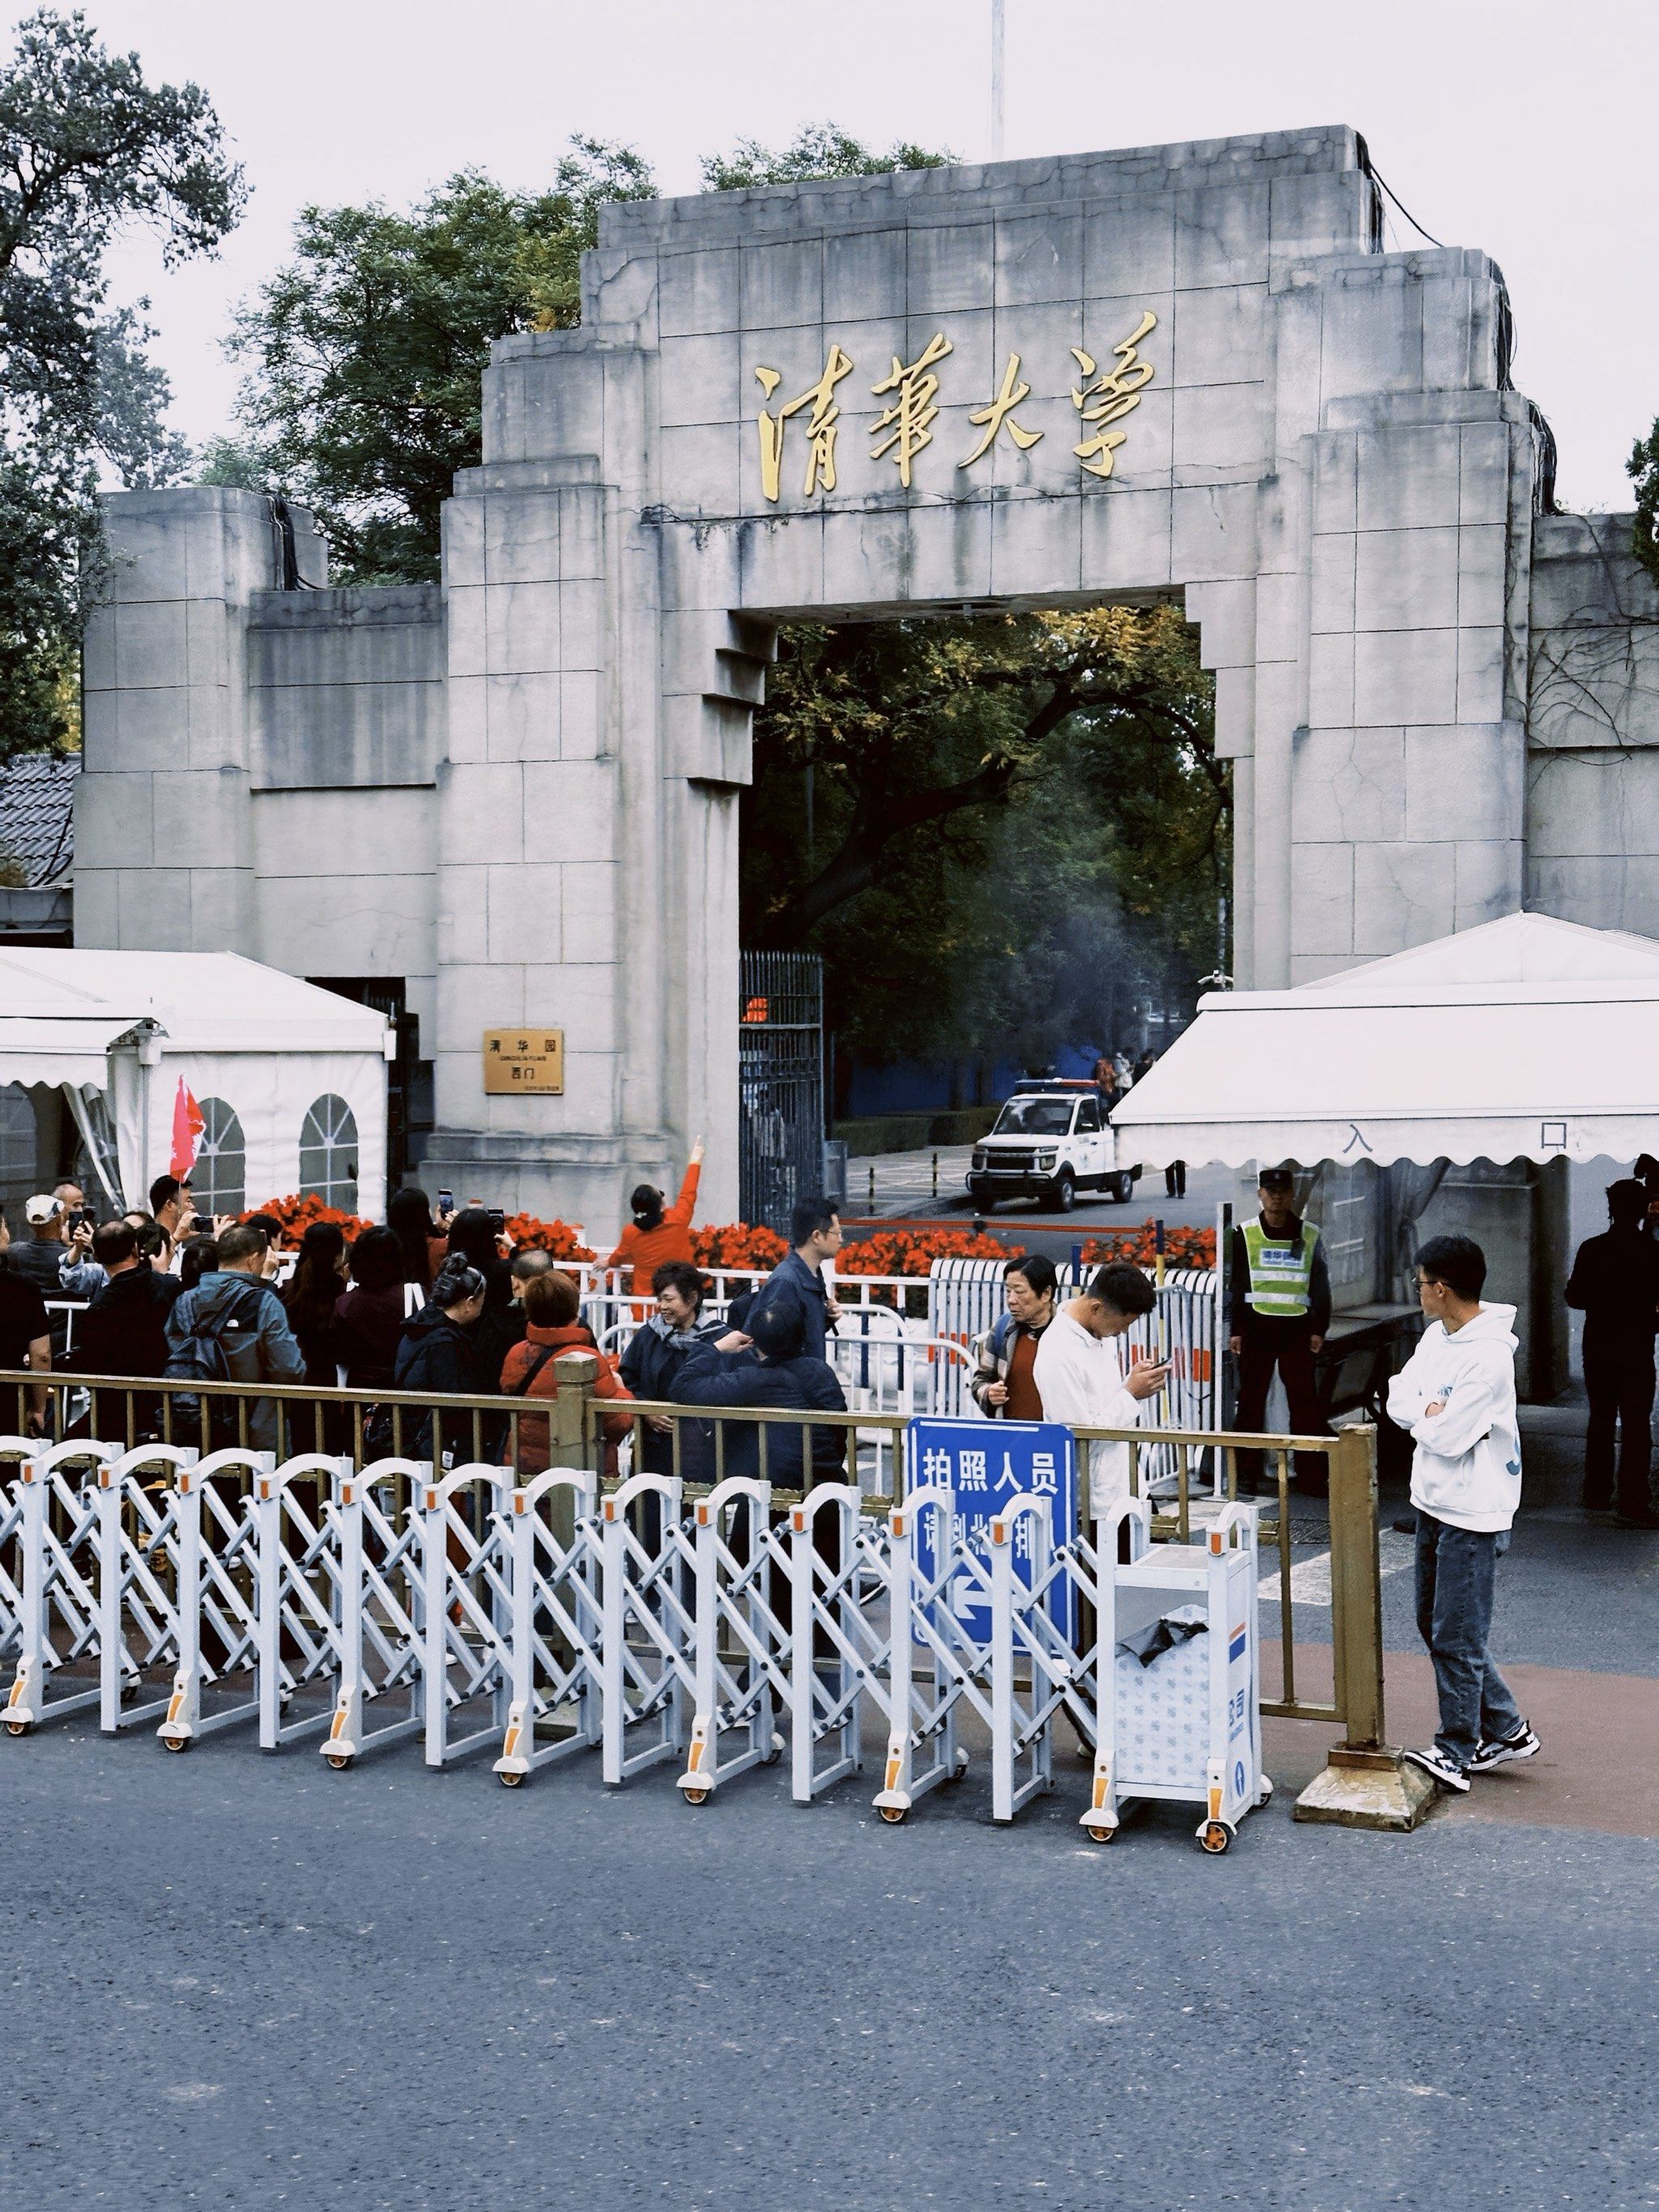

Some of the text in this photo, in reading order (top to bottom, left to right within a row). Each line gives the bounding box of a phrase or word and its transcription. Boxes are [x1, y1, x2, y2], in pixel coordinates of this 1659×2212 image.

[511, 1066, 535, 1080] 西门
[1341, 1122, 1567, 1155] 入口
[923, 1447, 1060, 1495] 拍照人员
